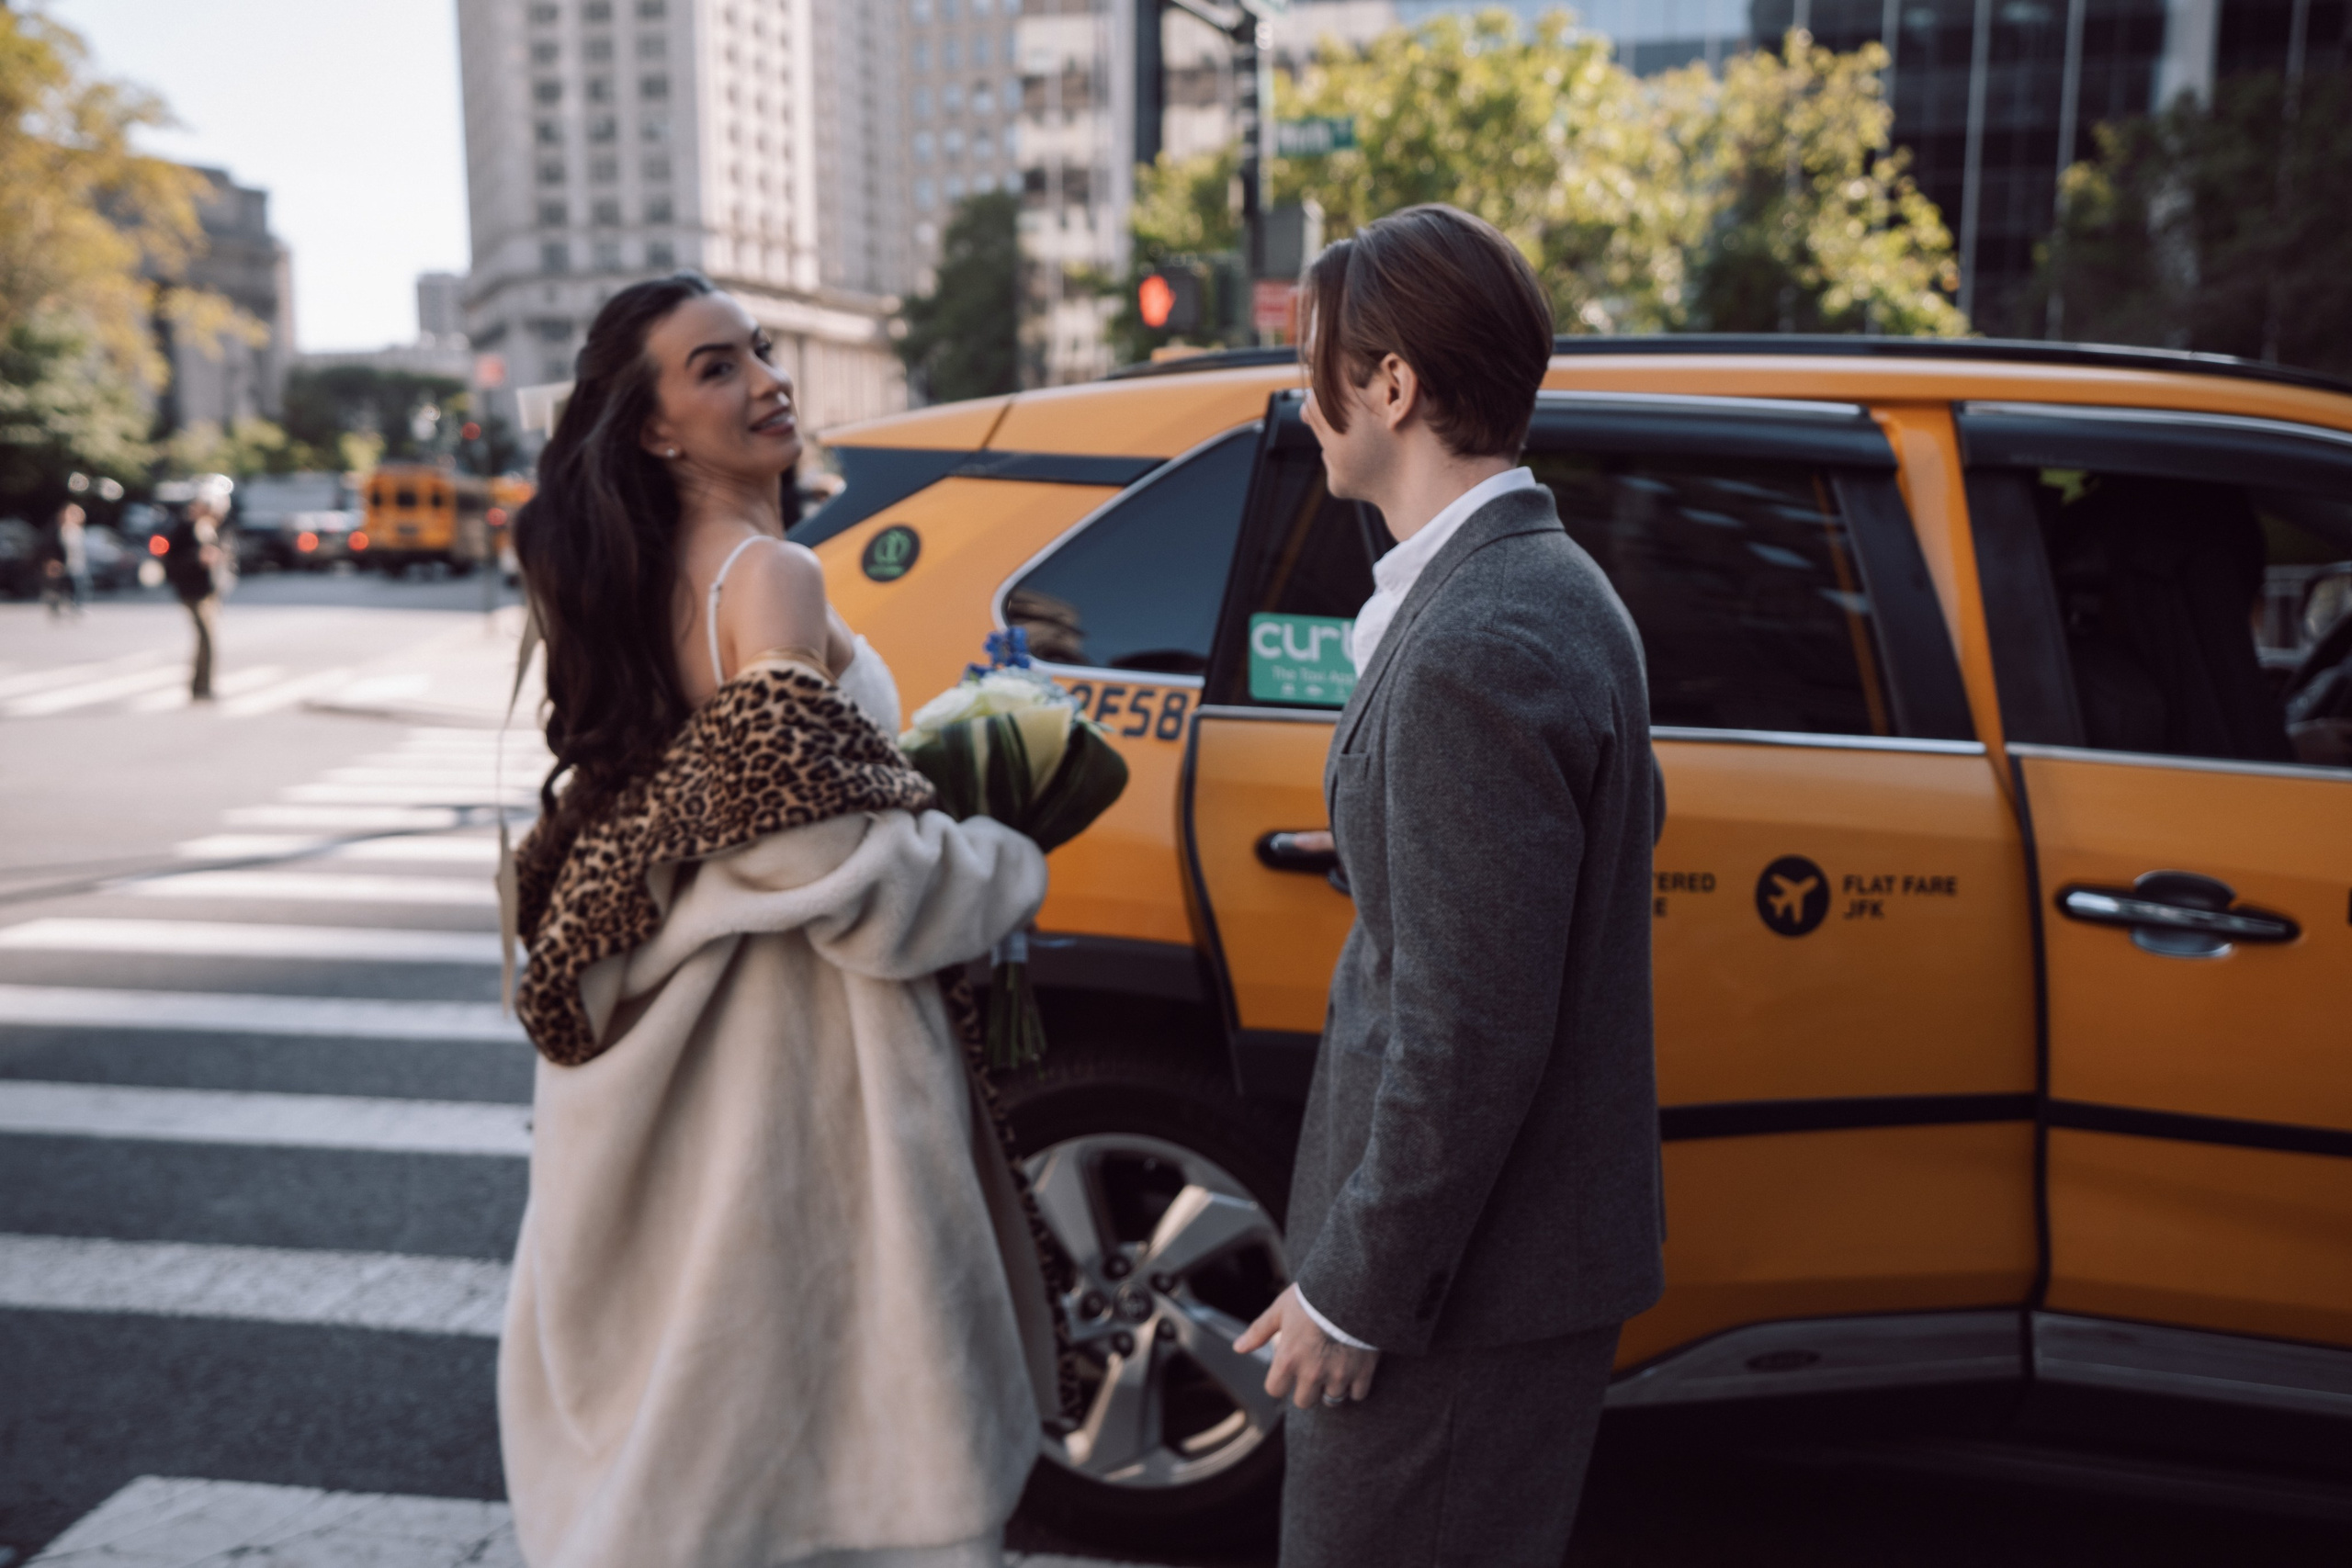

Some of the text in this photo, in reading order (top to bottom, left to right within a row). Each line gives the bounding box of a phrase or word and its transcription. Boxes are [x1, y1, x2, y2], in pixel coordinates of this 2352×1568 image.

[1842, 874, 1958, 897] FLAT FARE
[1842, 899, 1884, 919] JFK
